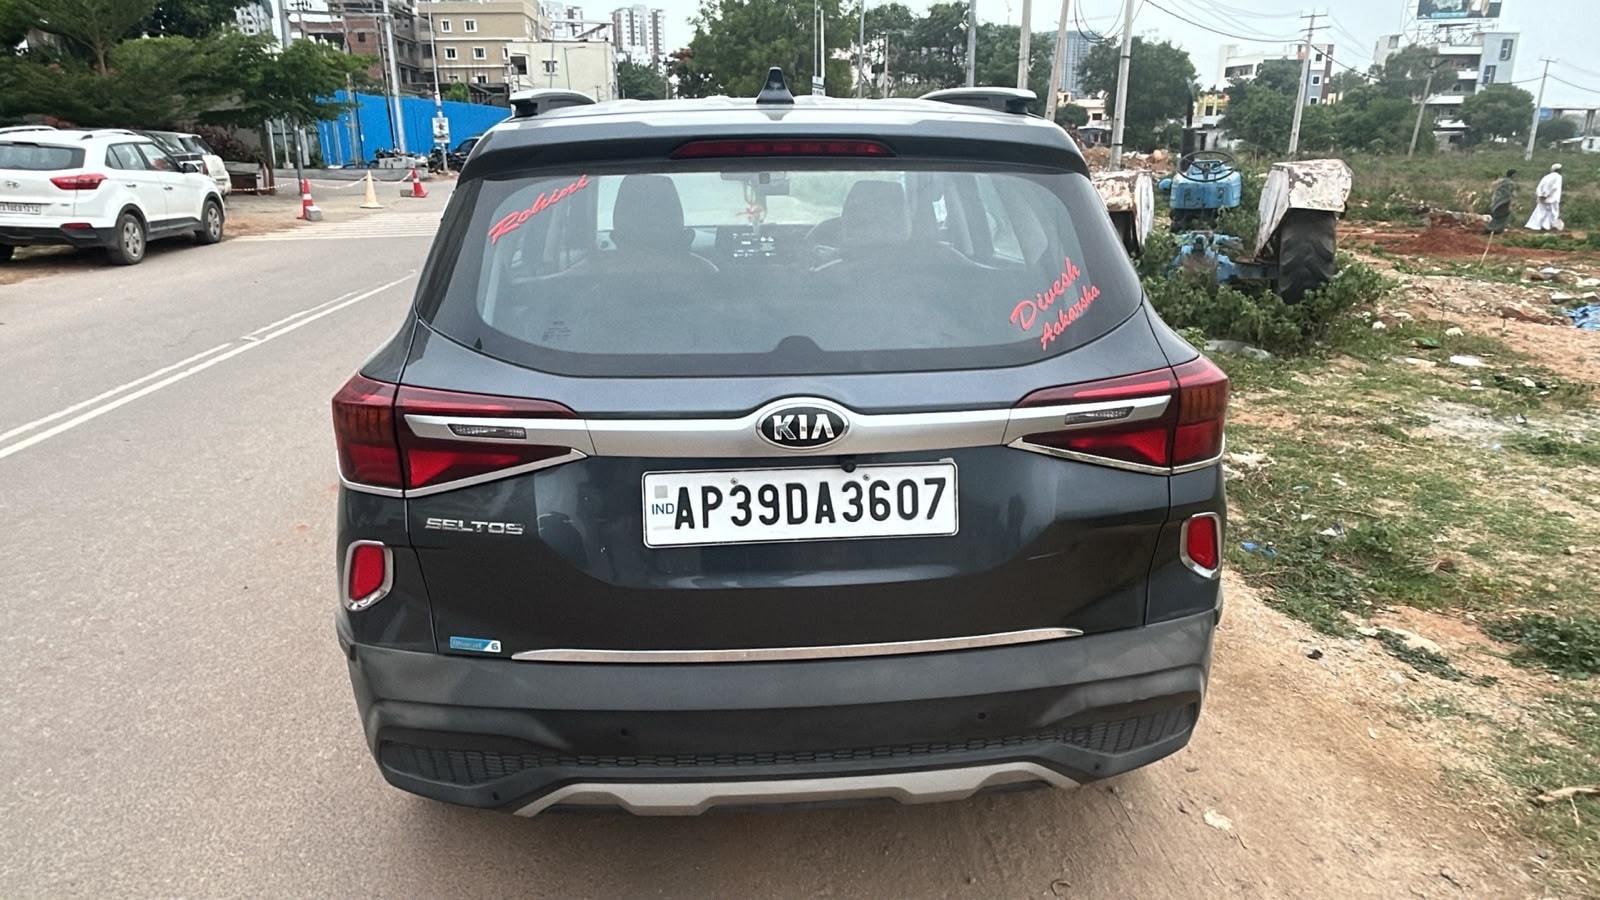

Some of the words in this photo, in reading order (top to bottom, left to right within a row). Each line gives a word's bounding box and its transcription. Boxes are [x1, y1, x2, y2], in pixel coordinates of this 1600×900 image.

[488, 174, 591, 245] Rohini
[1009, 256, 1081, 330] Divesh
[1041, 285, 1100, 351] Aakarsha
[772, 413, 835, 440] KIA
[425, 517, 525, 535] SELTOS
[651, 502, 674, 516] IND
[674, 477, 946, 530] AP39DA3607
